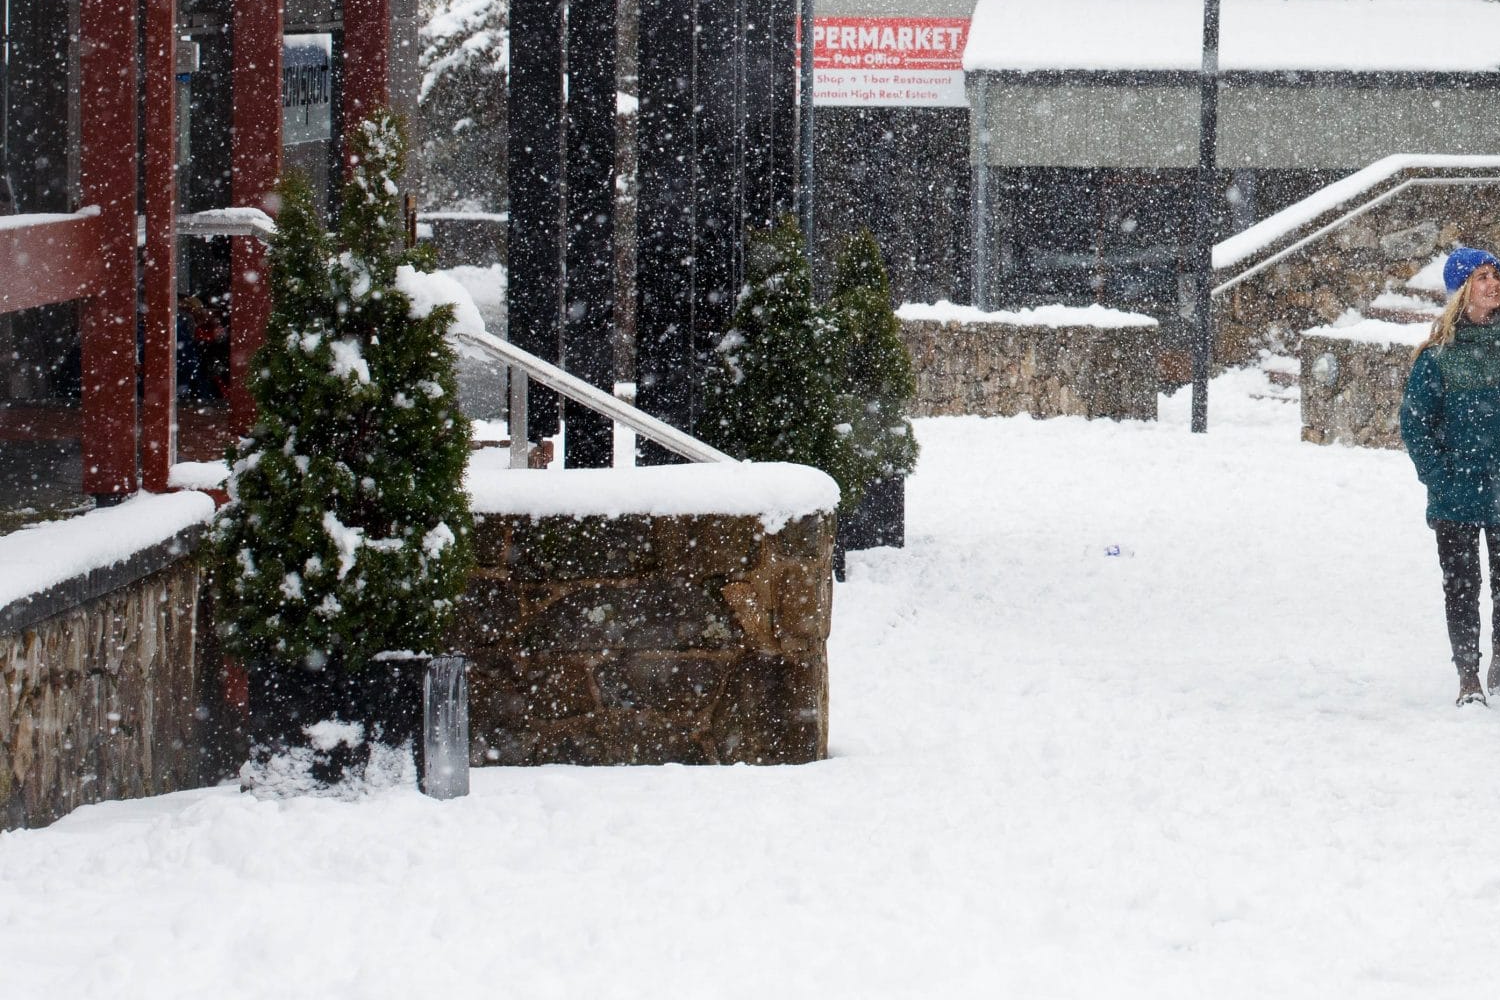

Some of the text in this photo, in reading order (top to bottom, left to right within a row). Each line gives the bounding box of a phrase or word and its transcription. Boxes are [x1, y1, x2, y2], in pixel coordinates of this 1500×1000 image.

[812, 26, 963, 51] PERMARKET
[834, 53, 901, 65] Post Office
[817, 74, 844, 86] Shop
[893, 74, 952, 85] Restaurant
[812, 89, 938, 101] untain High Real Estate
